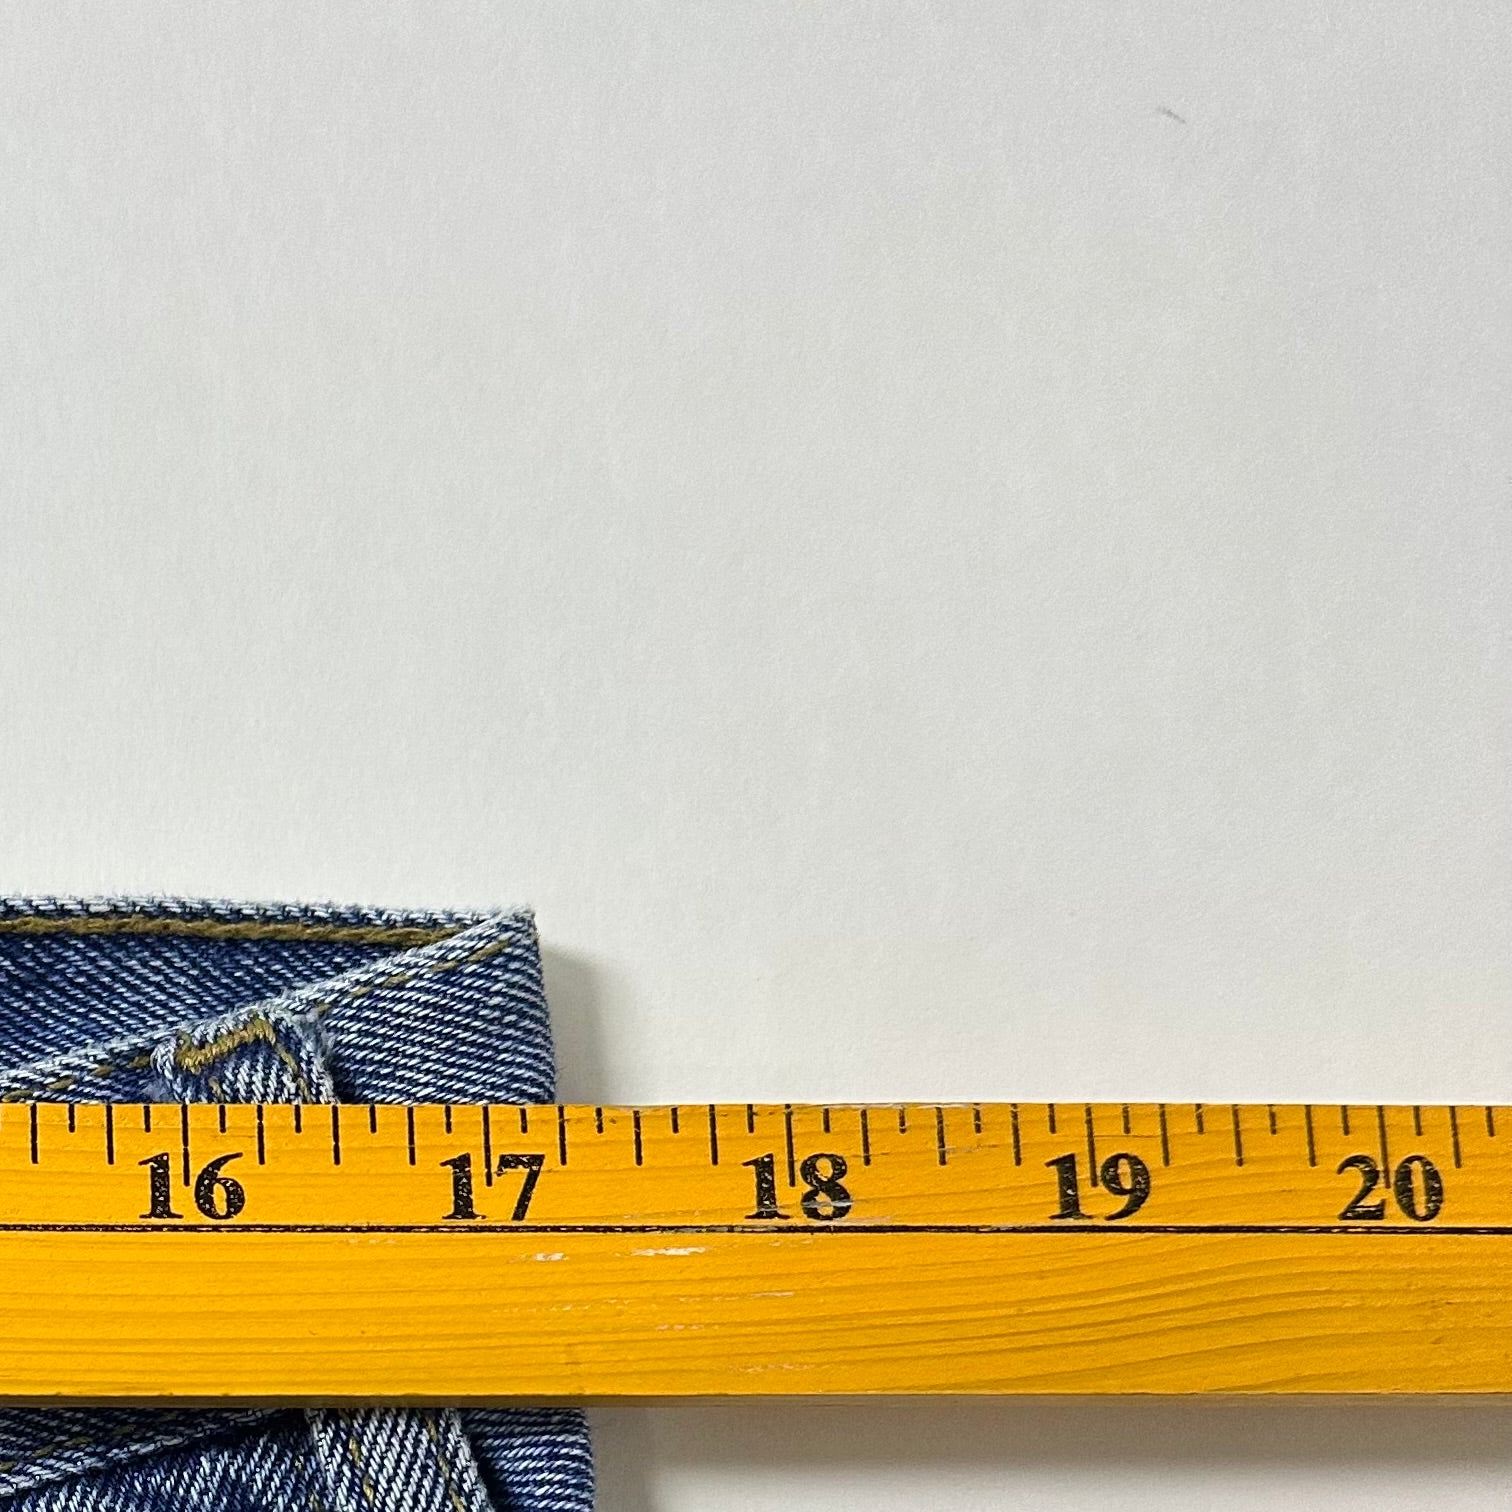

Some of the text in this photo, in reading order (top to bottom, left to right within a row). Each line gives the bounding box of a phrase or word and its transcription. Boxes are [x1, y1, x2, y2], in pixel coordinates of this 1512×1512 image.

[139, 1152, 245, 1219] 16
[440, 1152, 545, 1221] 17
[742, 1152, 853, 1221] 18
[1045, 1153, 1150, 1221] 19
[1337, 1154, 1444, 1221] 20
